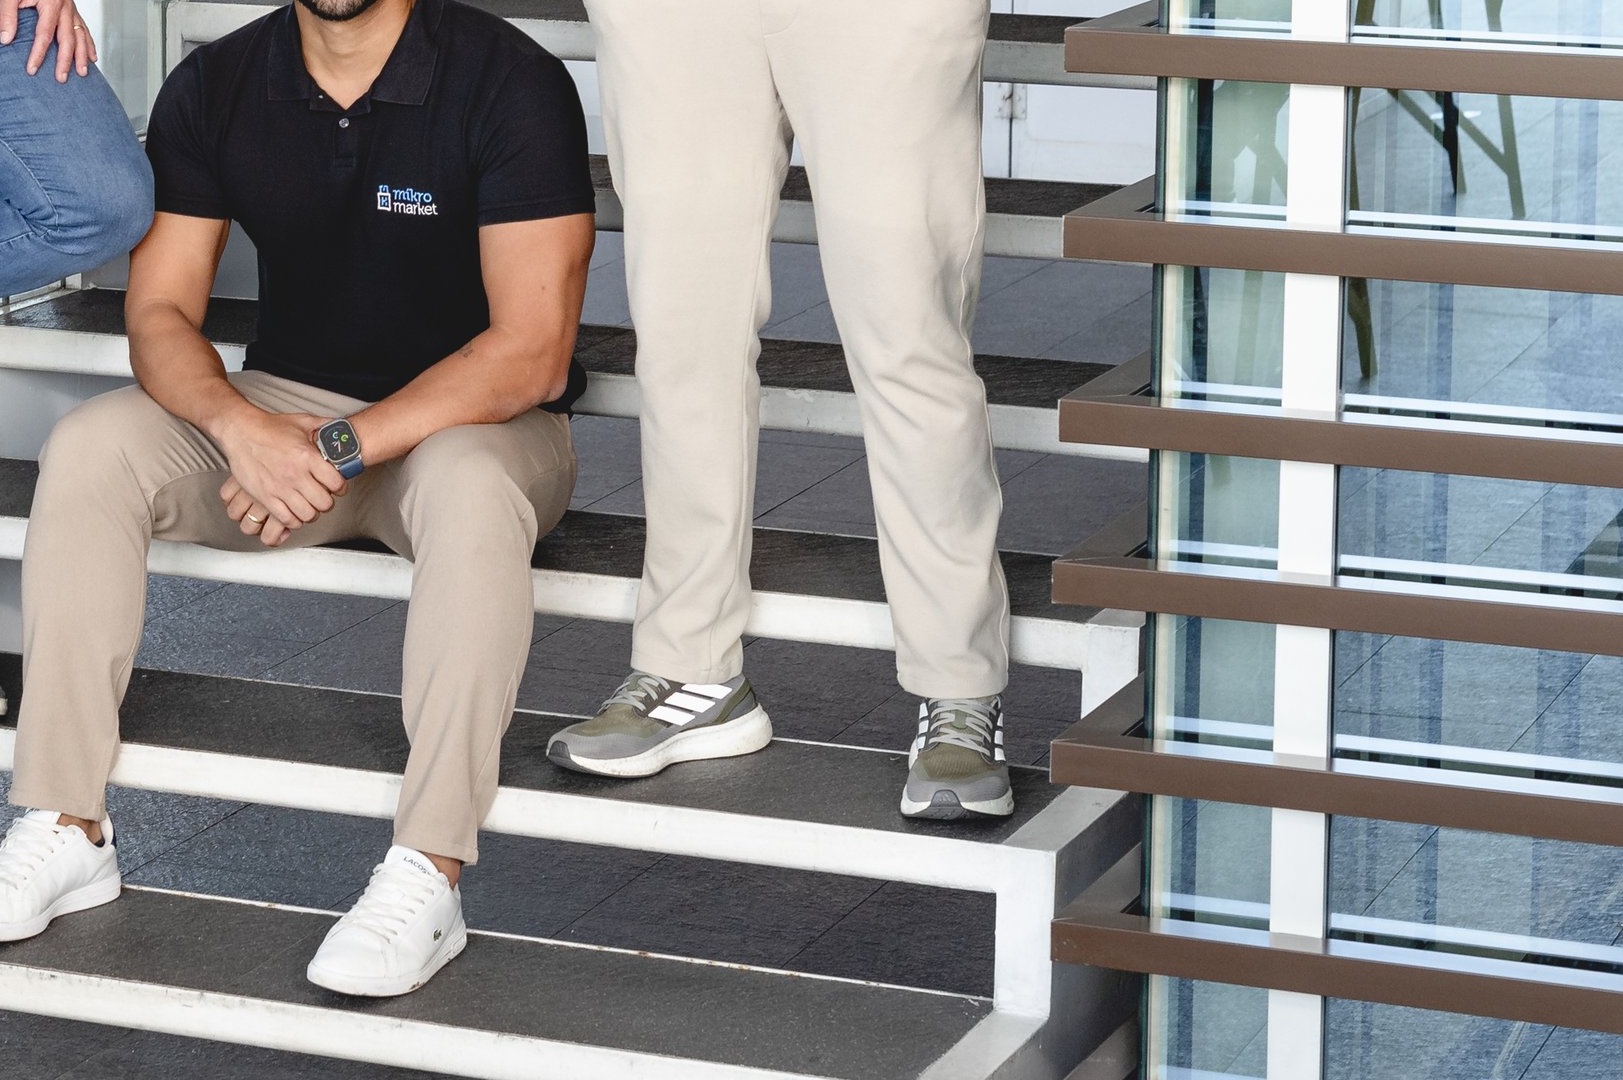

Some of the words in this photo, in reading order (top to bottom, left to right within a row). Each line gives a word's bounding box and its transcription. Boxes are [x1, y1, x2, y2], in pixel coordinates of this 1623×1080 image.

[392, 188, 432, 203] mikro
[393, 202, 438, 216] market
[403, 856, 432, 876] LACOS
